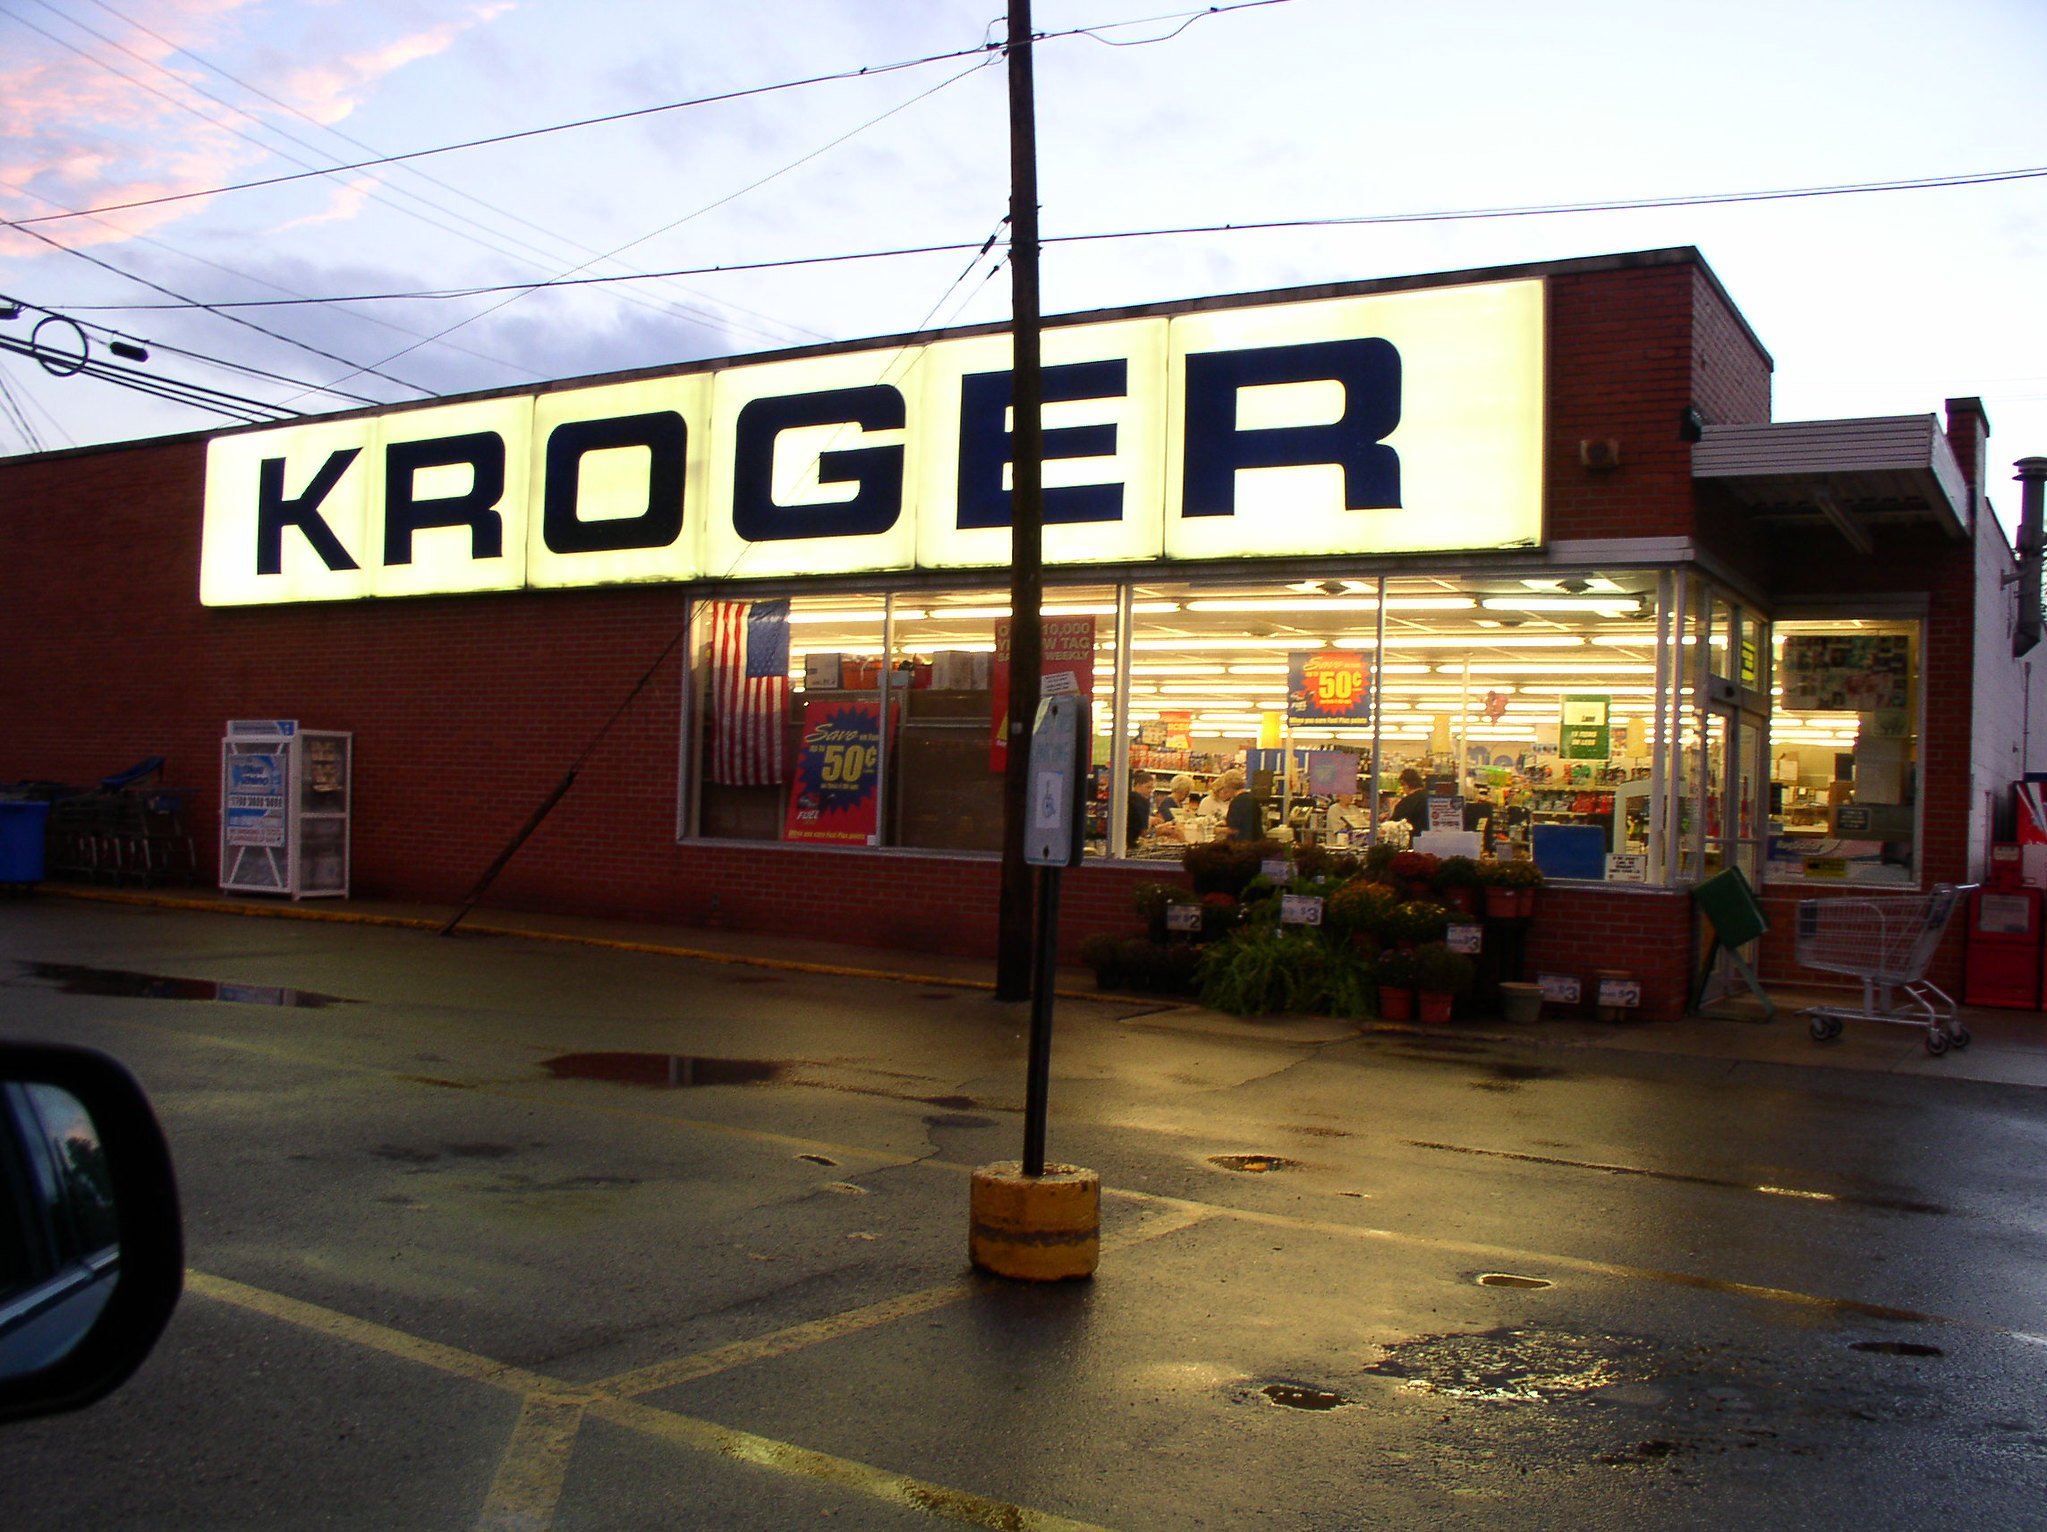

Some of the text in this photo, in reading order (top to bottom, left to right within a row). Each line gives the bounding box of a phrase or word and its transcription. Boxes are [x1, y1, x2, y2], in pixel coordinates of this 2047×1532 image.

[256, 337, 1403, 576] KROGER
[1062, 637, 1090, 649] TAG
[1046, 651, 1089, 661] WEEKLY
[804, 723, 858, 742] Save
